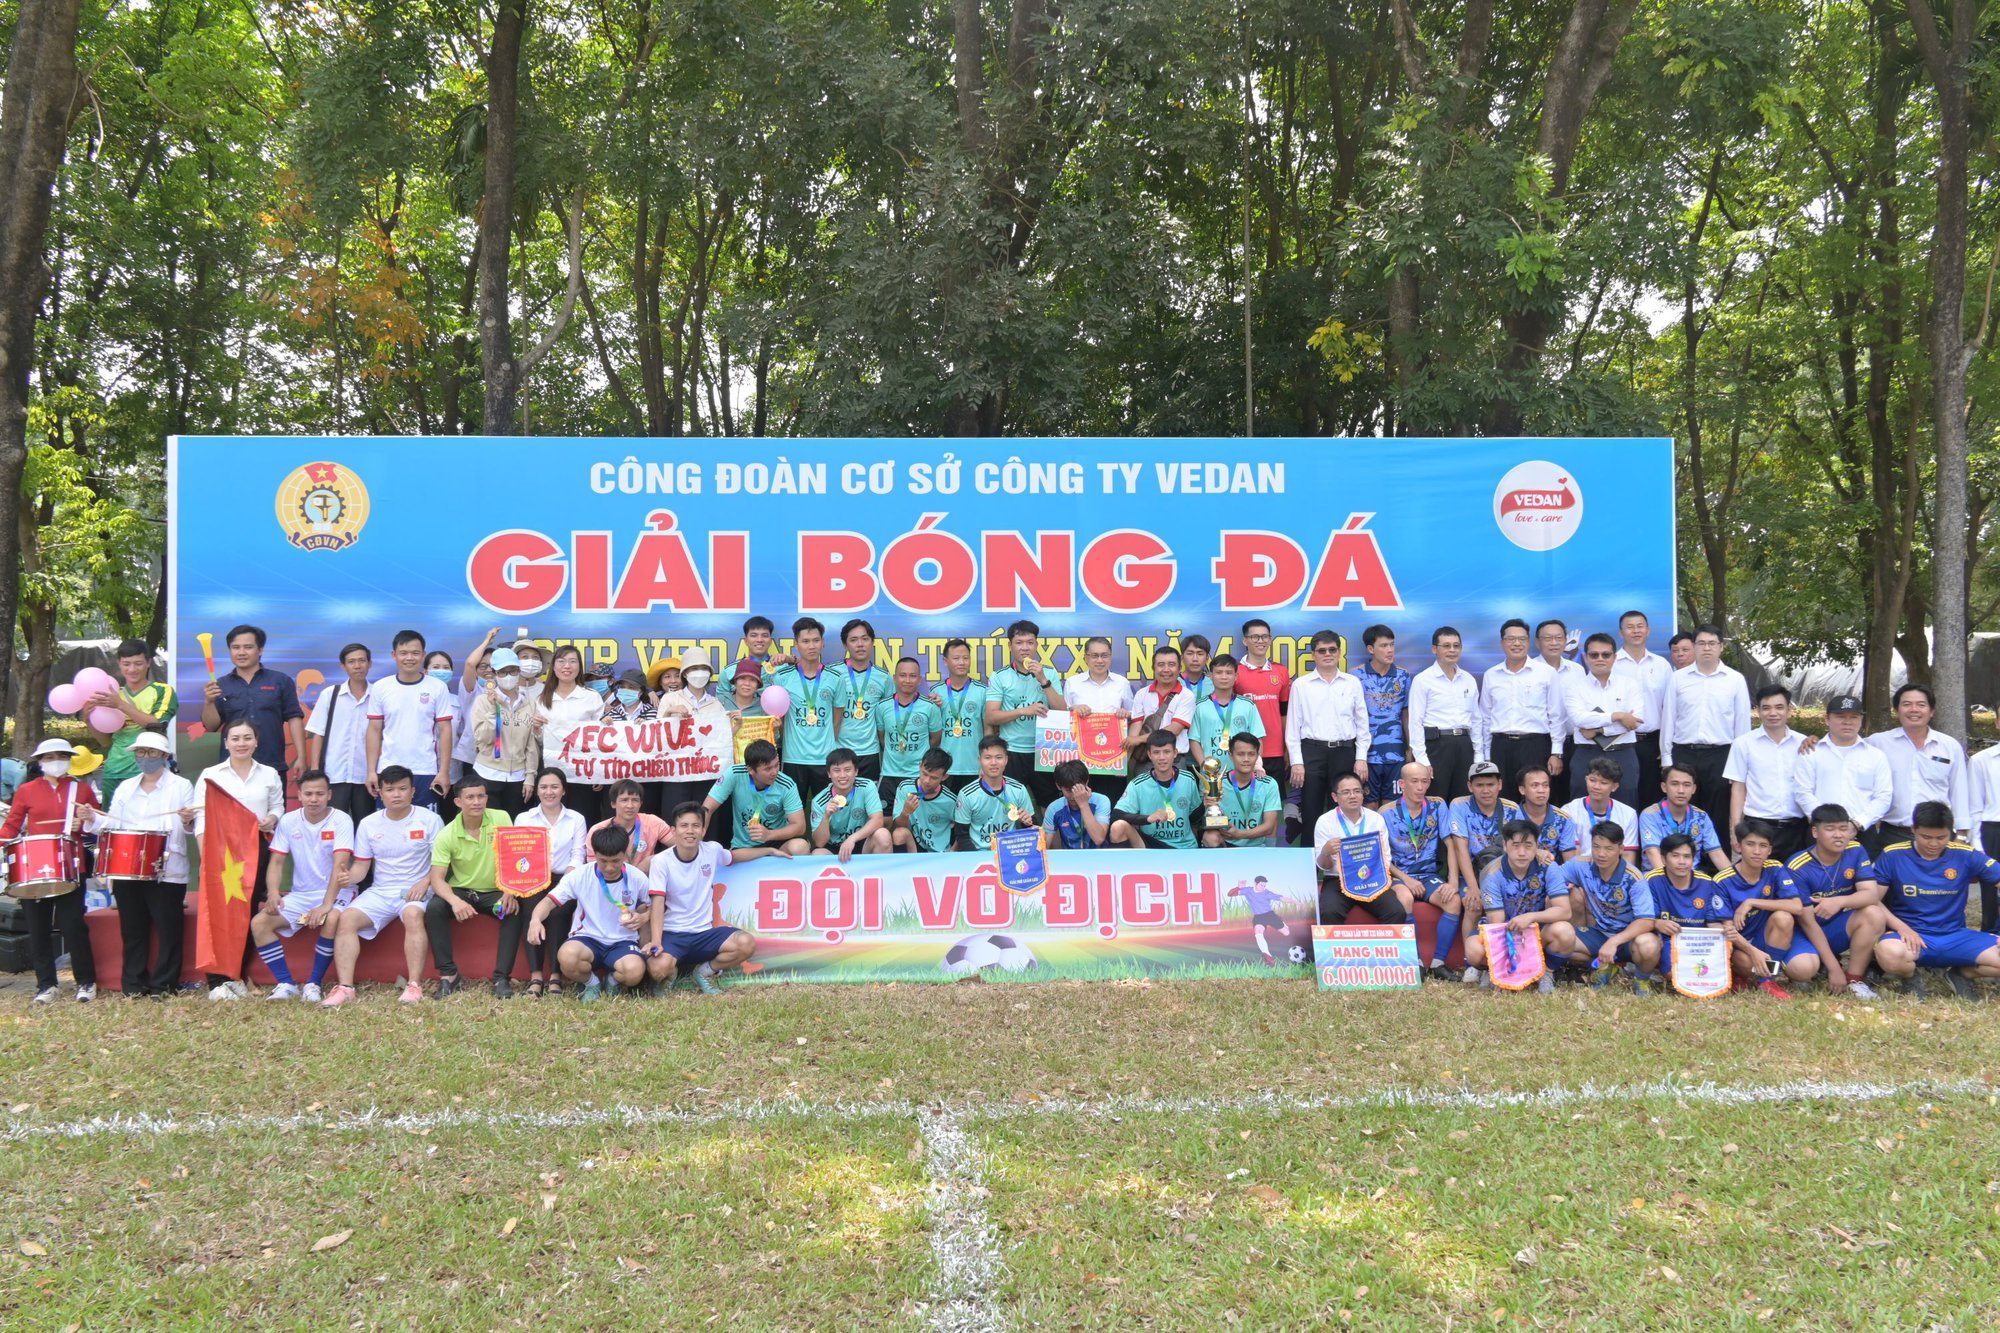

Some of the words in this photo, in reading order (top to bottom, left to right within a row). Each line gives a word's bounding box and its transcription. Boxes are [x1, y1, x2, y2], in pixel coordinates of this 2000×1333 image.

[590, 455, 702, 494] CÔNG
[714, 456, 827, 494] ĐOÀN
[841, 460, 896, 494] CƠ
[908, 452, 962, 494] SỞ
[975, 455, 1084, 494] CÔNG
[1097, 462, 1143, 494] TY
[1155, 462, 1285, 494] VEDAN
[1513, 493, 1562, 506] VEDAN
[1514, 512, 1532, 523] love
[1541, 514, 1563, 523] care
[306, 536, 339, 549] CĐVN
[465, 508, 751, 614] GIẢI
[797, 511, 1178, 614] BÓNG
[1210, 511, 1406, 612] ĐÁ
[795, 719, 826, 728] POER
[581, 725, 618, 753] FC
[944, 729, 972, 738] POER
[753, 866, 884, 945] ĐỘI
[911, 863, 1015, 929] VÔ
[1041, 872, 1224, 941] ĐỊCH
[1333, 946, 1371, 961] HẠNG
[1322, 966, 1418, 986] 6.000.000đ
